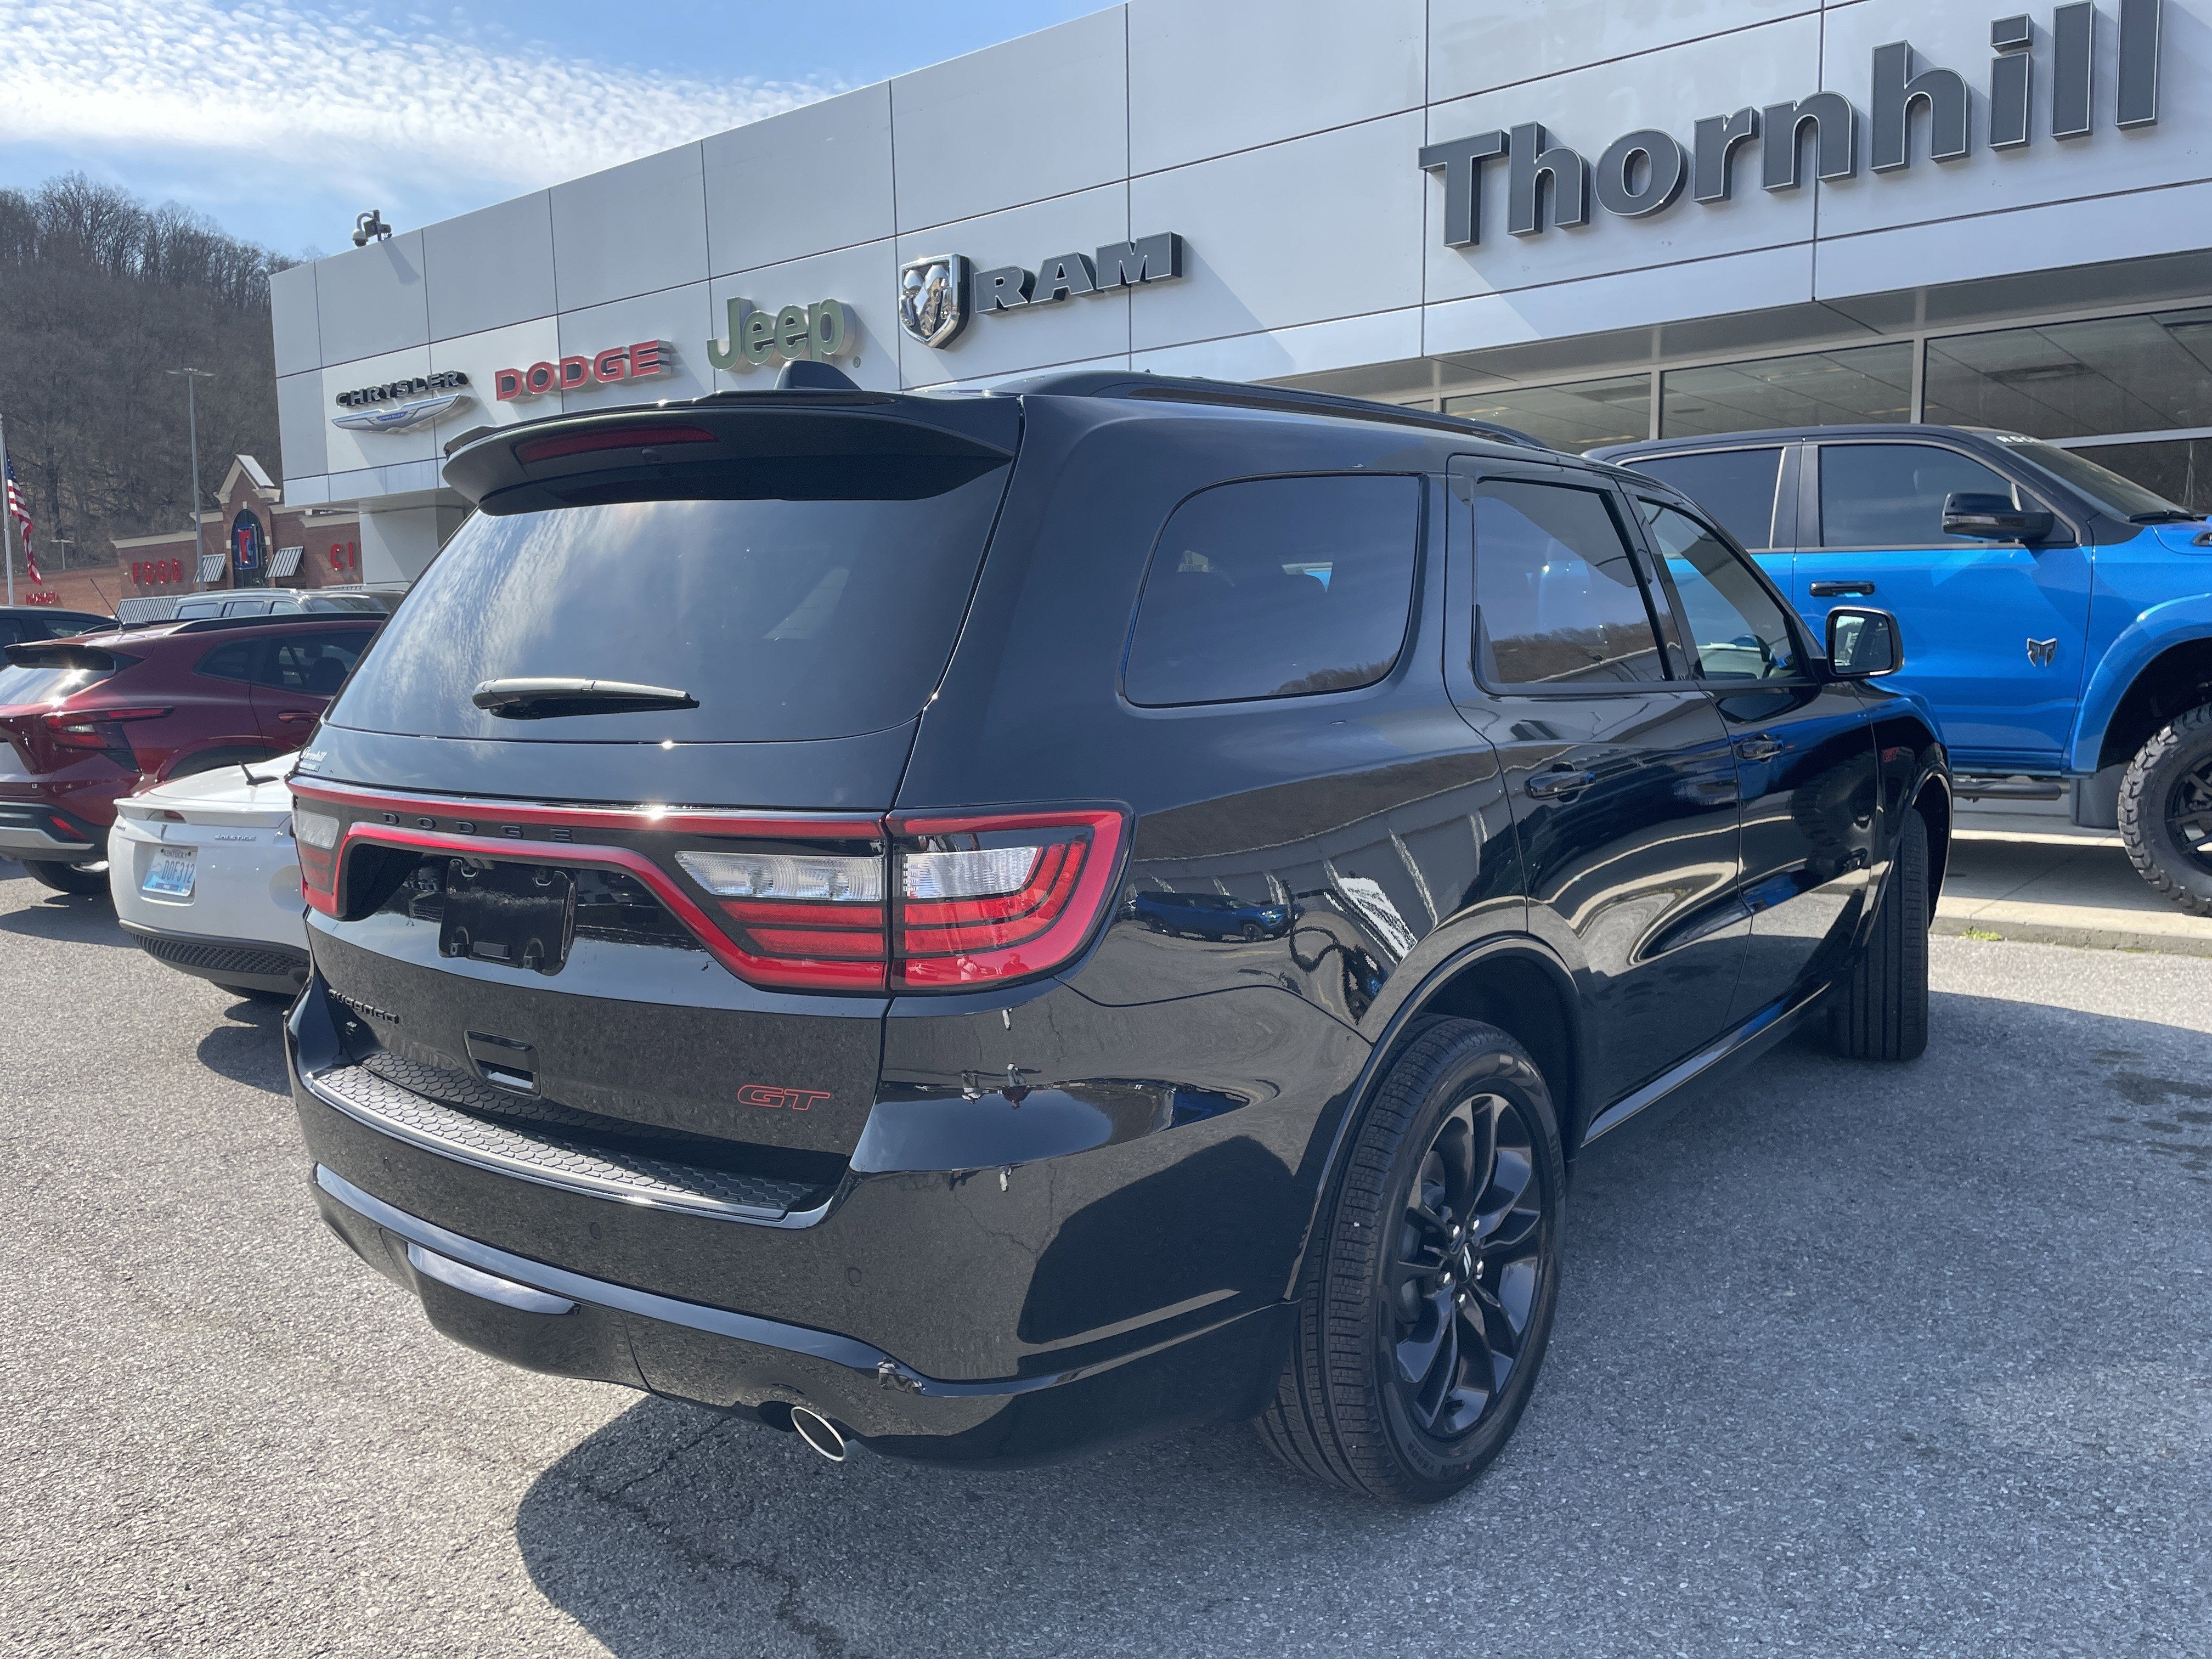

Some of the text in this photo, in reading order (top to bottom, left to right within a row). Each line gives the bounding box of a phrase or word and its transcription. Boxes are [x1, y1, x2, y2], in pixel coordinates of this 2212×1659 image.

[1418, 0, 2163, 249] Thornhill
[974, 231, 1182, 315] RAM
[707, 296, 855, 371] Jeep
[335, 370, 468, 408] CHRYSLER
[495, 339, 672, 402] DODGE
[132, 557, 181, 585] FOOD
[382, 812, 574, 843] DODGE
[163, 850, 188, 859] KENTUCKY
[737, 1084, 831, 1111] GT
